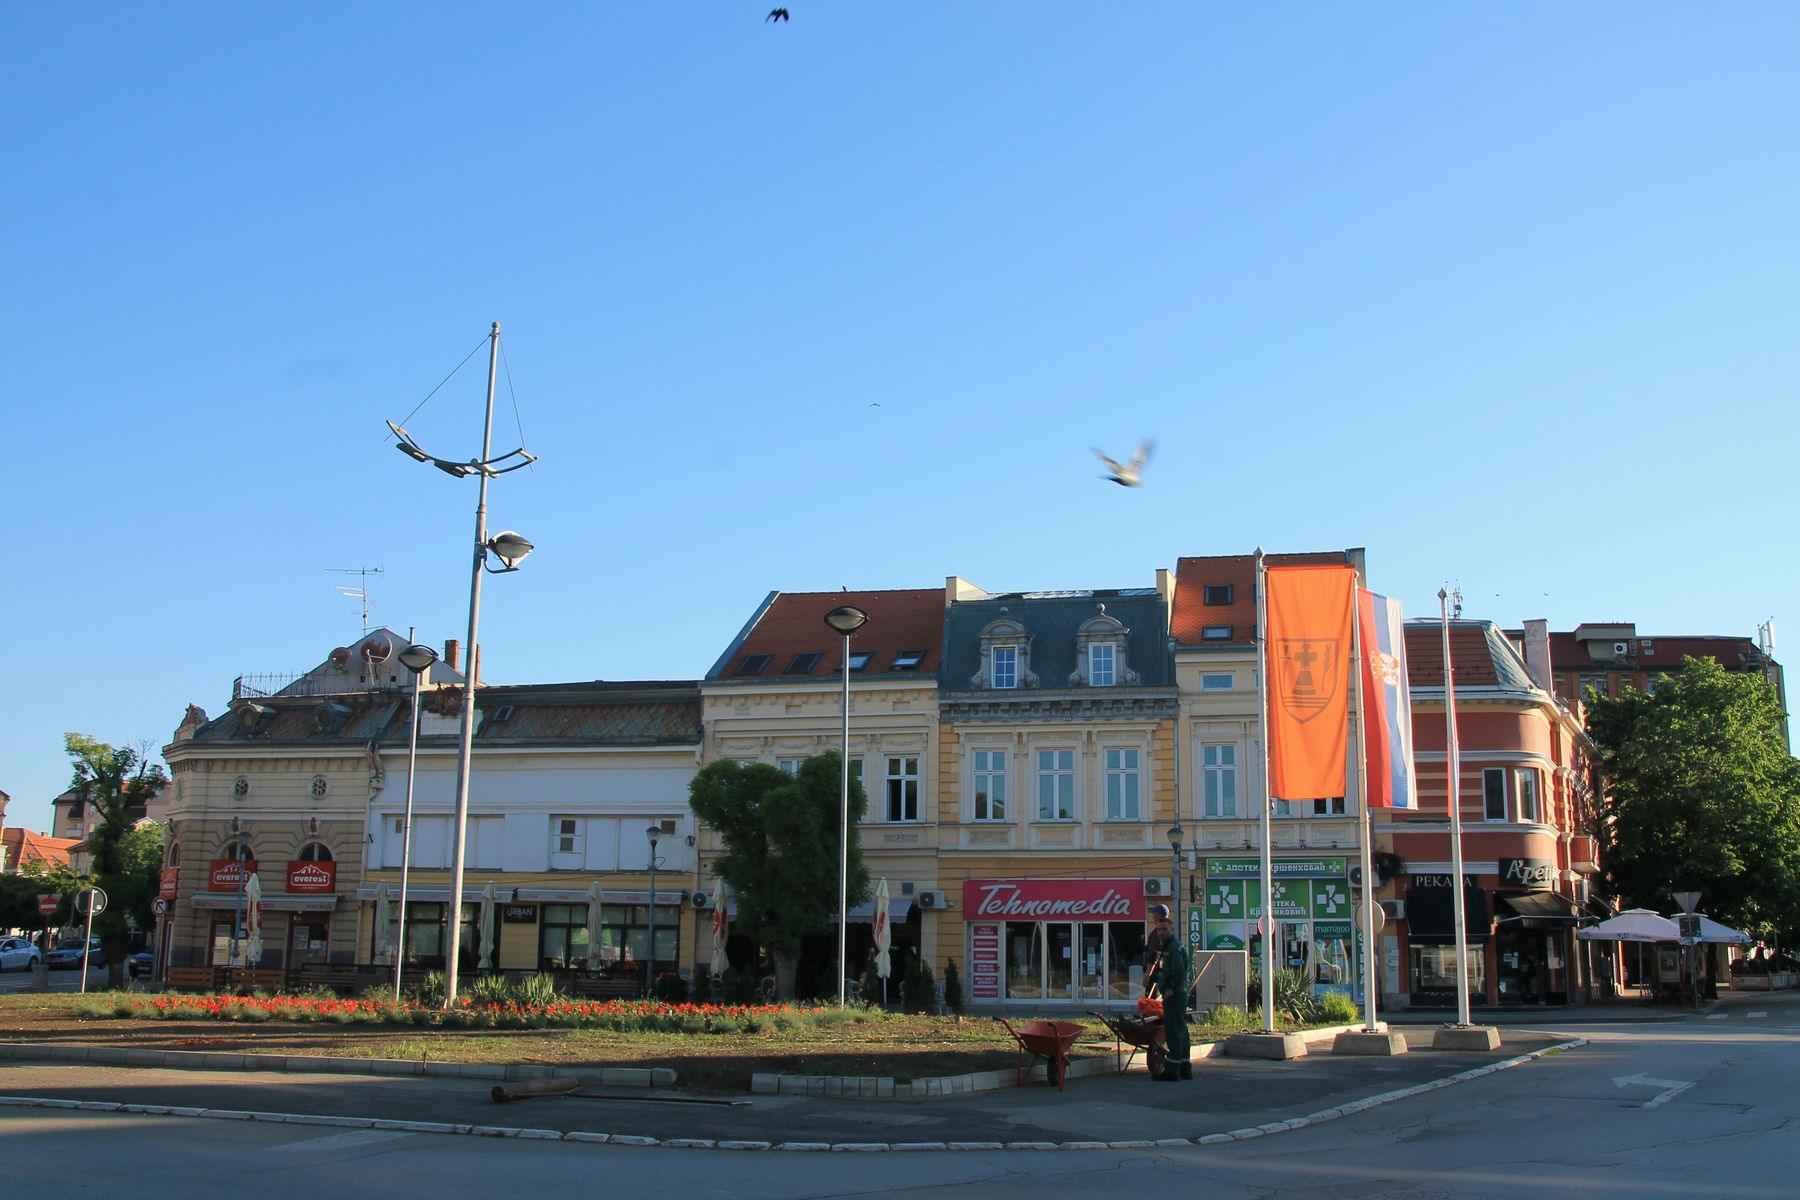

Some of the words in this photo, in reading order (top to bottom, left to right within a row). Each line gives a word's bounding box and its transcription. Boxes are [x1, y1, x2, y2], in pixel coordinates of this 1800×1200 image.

[1226, 864, 1262, 872] АПОТЕК
[216, 874, 248, 882] everet
[293, 875, 327, 883] everest
[1416, 876, 1473, 887] PEKAA
[977, 884, 1131, 916] Tehnomedia
[507, 906, 533, 917] URBAN
[1249, 905, 1306, 917] Крнковић
[1315, 925, 1350, 934] mamajoo
